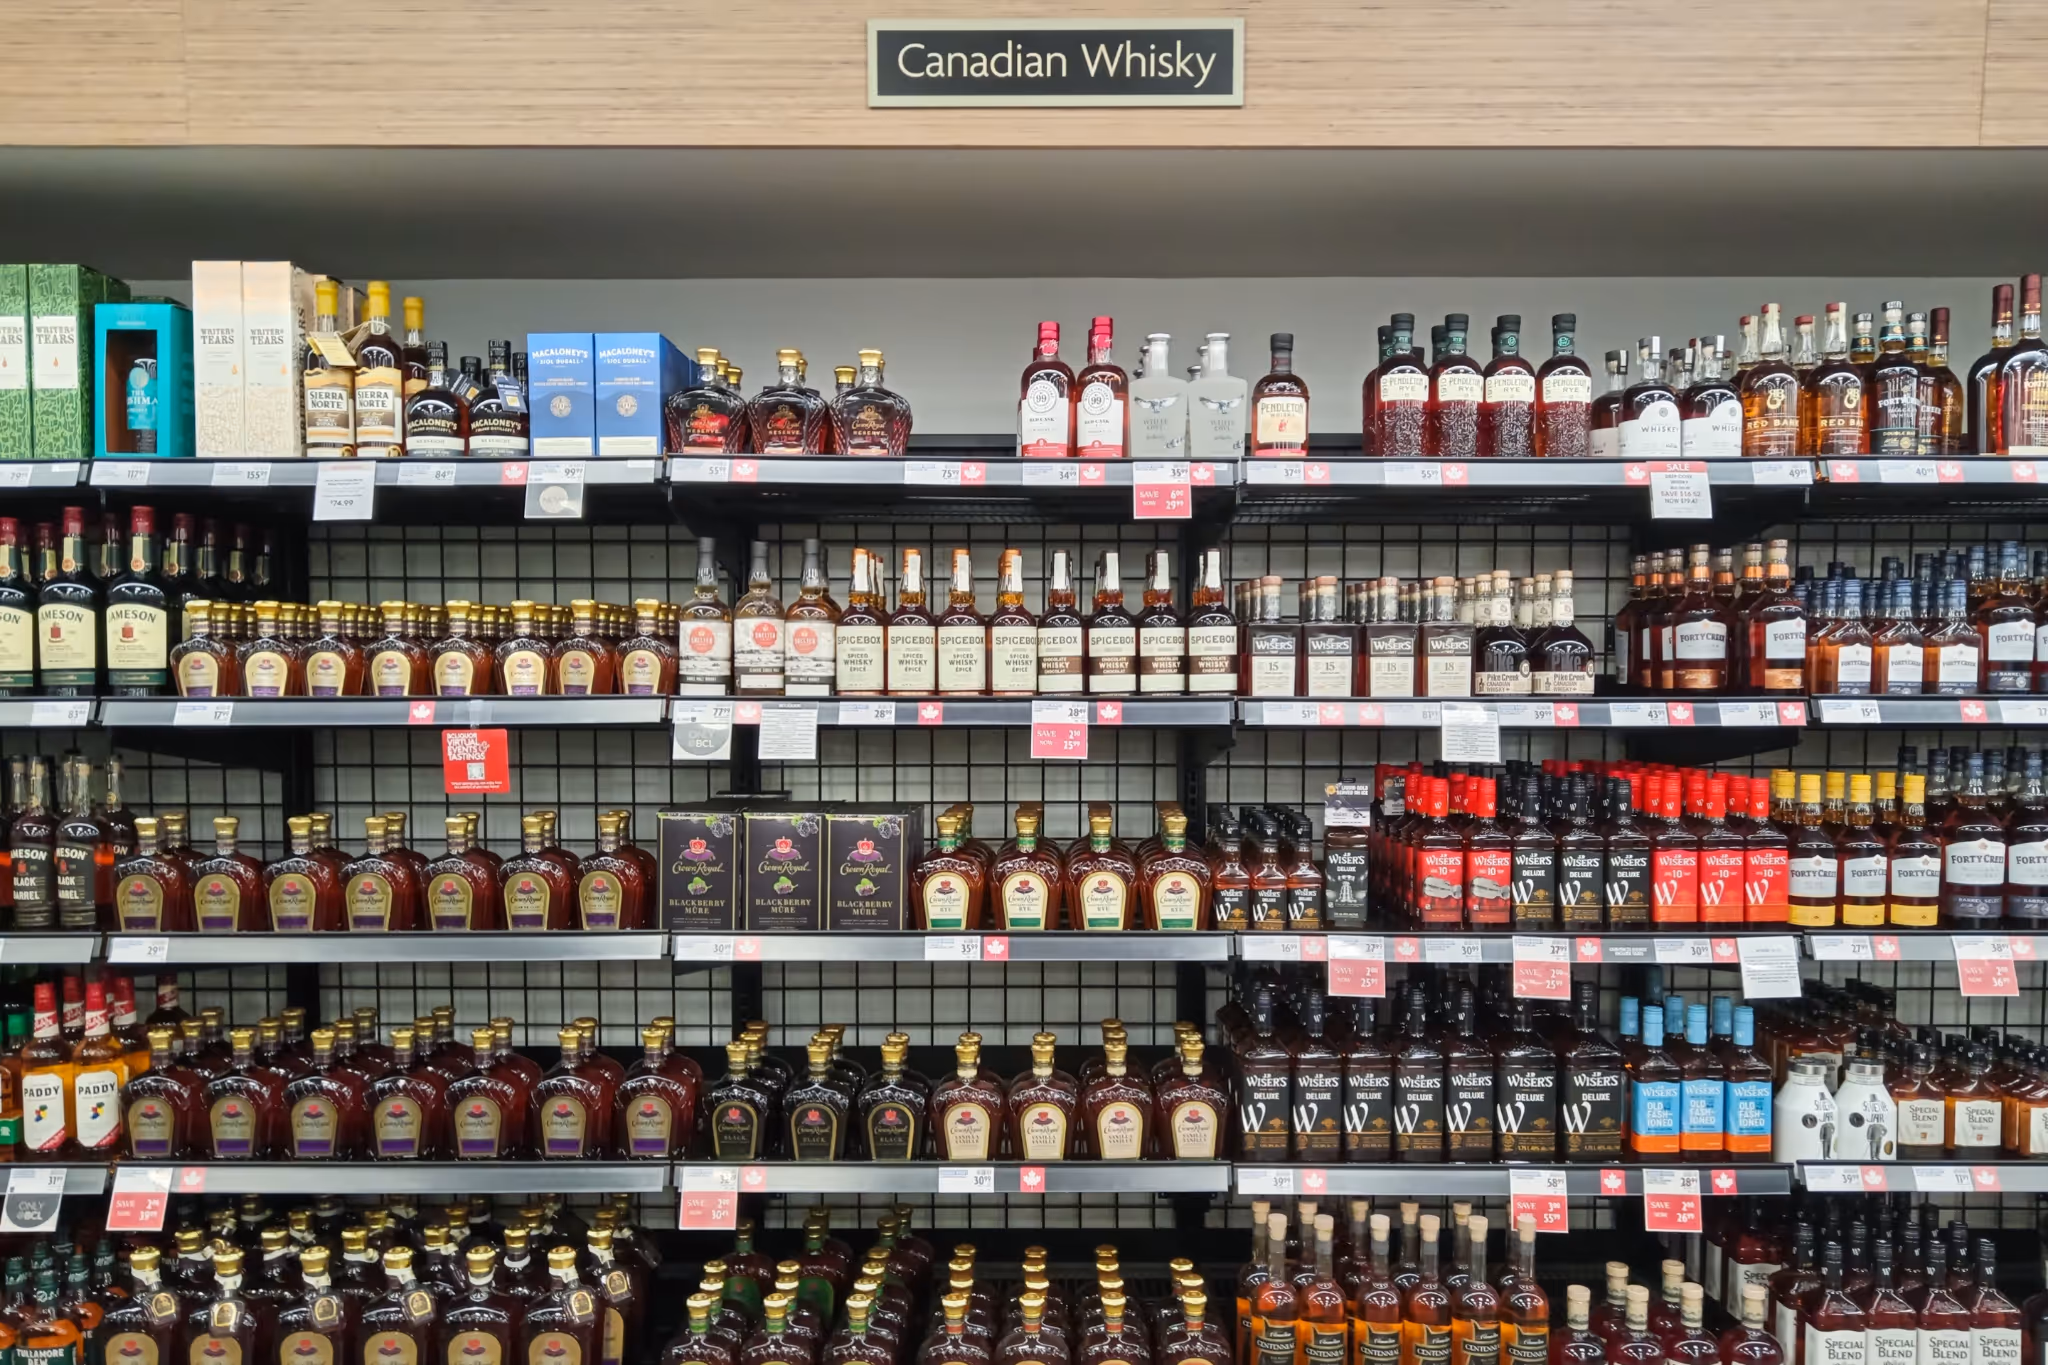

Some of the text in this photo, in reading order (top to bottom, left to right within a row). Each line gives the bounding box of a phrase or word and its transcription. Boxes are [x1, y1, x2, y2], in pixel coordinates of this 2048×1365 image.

[898, 40, 1216, 88] Canadian Whisky
[36, 334, 75, 345] TEARS
[201, 335, 234, 345] TEARS
[250, 335, 284, 345] TEARS
[532, 348, 588, 359] MACALONEY'S
[599, 348, 655, 358] MACALONEY'S
[1389, 377, 1424, 387] PENDLETON
[1449, 377, 1481, 386] PENDLETON
[1494, 378, 1529, 387] PENDLETON
[1553, 378, 1587, 387] PENDLETON
[309, 390, 344, 401] SIERRA
[357, 390, 389, 400] SIERRA
[1036, 394, 1047, 403] 99
[311, 399, 343, 409] NORTE
[358, 399, 388, 408] NORTE
[1090, 396, 1102, 405] 99
[1261, 403, 1304, 416] PENDLETON
[407, 418, 457, 431] MACALONEY'S
[471, 418, 521, 431] MACALONEY'S
[1747, 421, 1768, 429] RED
[1820, 418, 1847, 427] RED
[1666, 463, 1690, 471] SALE
[39, 610, 84, 623] JAMESON
[107, 609, 157, 623] JAMESON
[837, 636, 881, 645] SPICEBOX
[891, 636, 934, 645] SPICEBOX
[940, 636, 984, 645] SPICEBOX
[1091, 636, 1134, 645] SPICEBOX
[1191, 635, 1235, 645] SPICEBOX
[1680, 632, 1705, 643] FORTY
[1255, 638, 1293, 650] WISER'S
[1311, 638, 1349, 650] WISER'S
[1373, 638, 1412, 650] WISER'S
[1430, 638, 1469, 650] WISER'S
[1041, 661, 1070, 669] WHISKY
[1098, 661, 1129, 669] WHISKY
[1152, 661, 1181, 669] WHISKY
[1198, 661, 1230, 669] WHISKY
[1268, 662, 1279, 671] 15
[1324, 662, 1335, 671] 15
[1386, 662, 1397, 672] 18
[1444, 662, 1455, 672] 18
[1486, 673, 1519, 682] Pike Creek
[1553, 673, 1586, 682] Pike Creek
[447, 738, 480, 747] VIRTUAL
[447, 745, 478, 754] EVENTS
[448, 752, 485, 761] TASTINGS
[1328, 855, 1365, 865] WISER'S
[1425, 856, 1461, 866] WISER'S
[1474, 857, 1510, 866] WISER'S
[1515, 855, 1552, 866] WISER'S
[1563, 857, 1600, 867] WISER'S
[1610, 857, 1647, 866] WISER'S
[1659, 856, 1696, 866] WISER'S
[1706, 856, 1742, 866] WISER'S
[1750, 855, 1786, 865] WISER'S
[1951, 855, 1983, 864] FORTY
[2016, 855, 2047, 864] FORTY
[672, 860, 722, 876] Crown Royal
[758, 860, 808, 875] Crown Royal
[840, 862, 889, 877] Crown Royal
[1438, 867, 1448, 875] 10
[1487, 867, 1496, 875] 10
[1522, 869, 1545, 877] DELUXE
[1617, 870, 1640, 878] DELUXE
[1672, 870, 1683, 878] 10
[1719, 870, 1729, 878] 10
[1763, 868, 1774, 877] 10
[1791, 869, 1818, 878] FORTY
[1852, 869, 1878, 878] FORTY
[1898, 869, 1925, 878] FORTY
[1511, 878, 1534, 905] W
[1654, 879, 1678, 906] W
[669, 899, 726, 907] BLACKBERRY
[755, 898, 812, 906] BLACKBERRY
[837, 900, 893, 909] BLACKBERRY
[685, 905, 710, 914] MÛRE
[770, 904, 796, 914] MÛRE
[852, 906, 877, 916] MÛRE
[1246, 1076, 1287, 1088] WISER'S
[1298, 1076, 1339, 1088] WISER'S
[1349, 1076, 1390, 1087] WISER'S
[1400, 1077, 1441, 1089] WISER'S
[1452, 1075, 1492, 1087] WISER'S
[1507, 1075, 1553, 1088] WISER'S
[1573, 1075, 1618, 1087] WISER'S
[24, 1085, 60, 1098] PADDY
[78, 1082, 116, 1095] PADDY
[1642, 1087, 1678, 1097] WISER'S
[1685, 1086, 1721, 1096] WISER'S
[1734, 1087, 1770, 1097] WISER'S
[1254, 1092, 1280, 1100] DELUXE
[1306, 1092, 1332, 1100] DELUXE
[1356, 1092, 1382, 1100] DELUXE
[1407, 1093, 1433, 1101] DELUXE
[1459, 1091, 1485, 1099] DELUXE
[1516, 1093, 1544, 1102] DELUXE
[1582, 1093, 1610, 1101] DELUXE
[1647, 1102, 1663, 1110] OLD
[1690, 1100, 1705, 1108] OLD
[1739, 1101, 1755, 1110] OLD
[1690, 1108, 1715, 1116] FASH-
[1909, 1104, 1940, 1114] SPECIAL
[1966, 1106, 1995, 1116] SPECIAL
[1241, 1102, 1266, 1133] W
[1497, 1101, 1525, 1134] W
[1647, 1110, 1674, 1119] FASH-
[1739, 1110, 1765, 1119] FASH-
[1911, 1113, 1938, 1122] BLEND
[1968, 1114, 1994, 1124] BLEND
[1648, 1118, 1673, 1127] IONED
[1690, 1116, 1716, 1125] IONED
[1739, 1118, 1765, 1127] IONED
[1517, 1202, 1536, 1210] SAVE
[1650, 1201, 1670, 1209] SAVE
[1825, 1338, 1864, 1349] SPECIAL
[1875, 1336, 1915, 1348] SPECIAL
[1929, 1337, 1969, 1349] SPECIAL
[1979, 1336, 2019, 1347] SPECIAL
[16, 1349, 65, 1358] TULLAMORE
[1828, 1348, 1862, 1360] BLEND
[1878, 1347, 1913, 1358] BLEND
[1932, 1348, 1967, 1359] BLEND
[1982, 1346, 2017, 1358] BLEND
